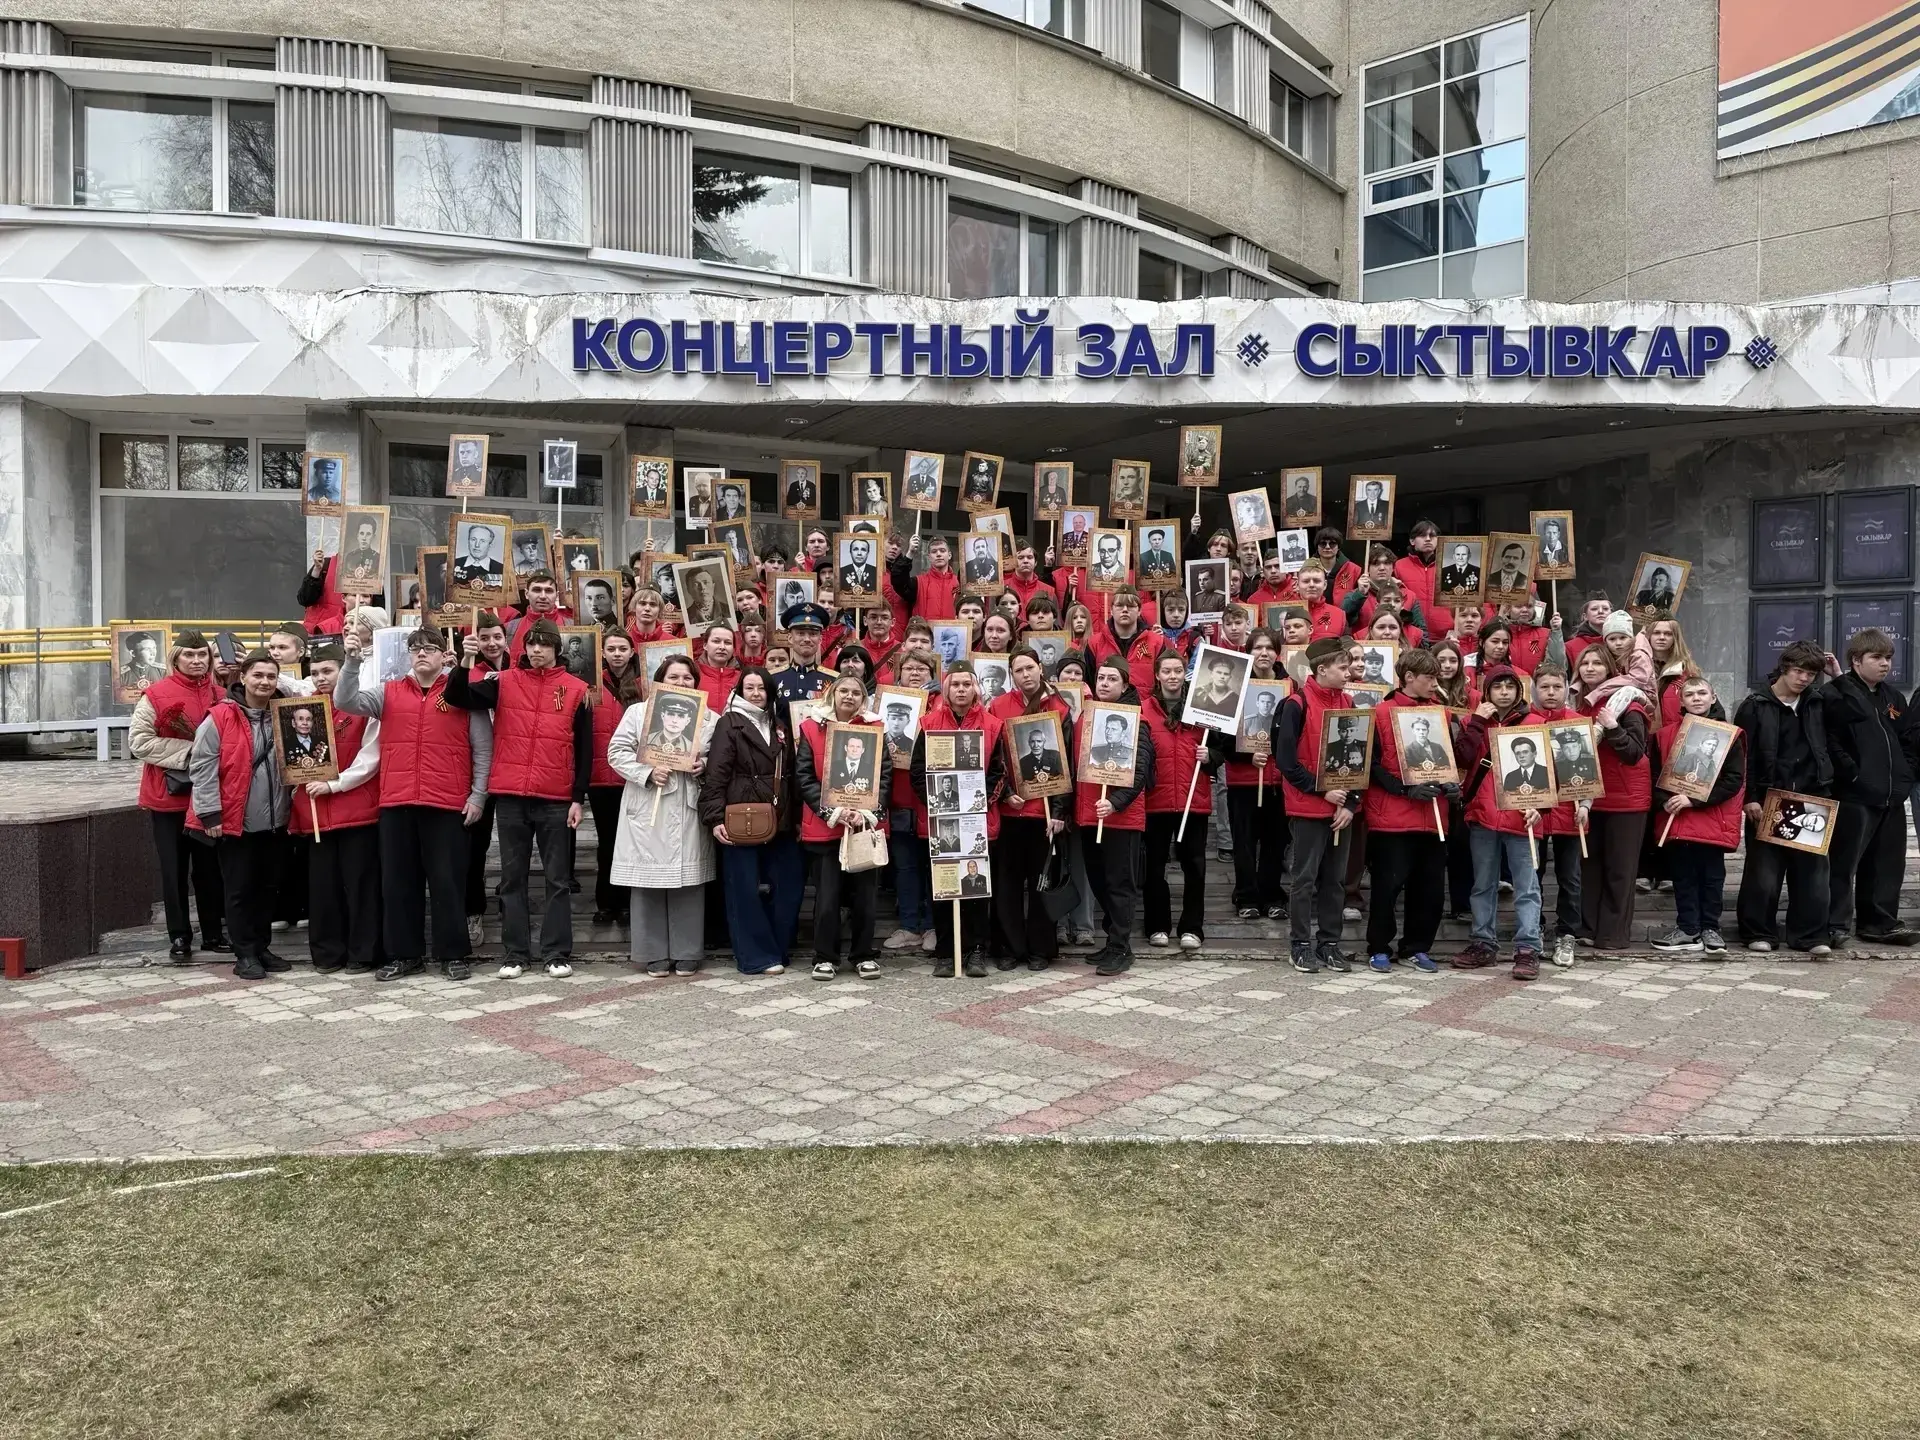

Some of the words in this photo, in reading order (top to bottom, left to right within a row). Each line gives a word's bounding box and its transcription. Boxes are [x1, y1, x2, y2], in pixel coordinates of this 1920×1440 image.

[572, 309, 1053, 386] КОНЦЕРТНЫЙ
[1075, 322, 1216, 378] ЗАЛ
[1294, 322, 1731, 379] СЫКТЫВКАР
